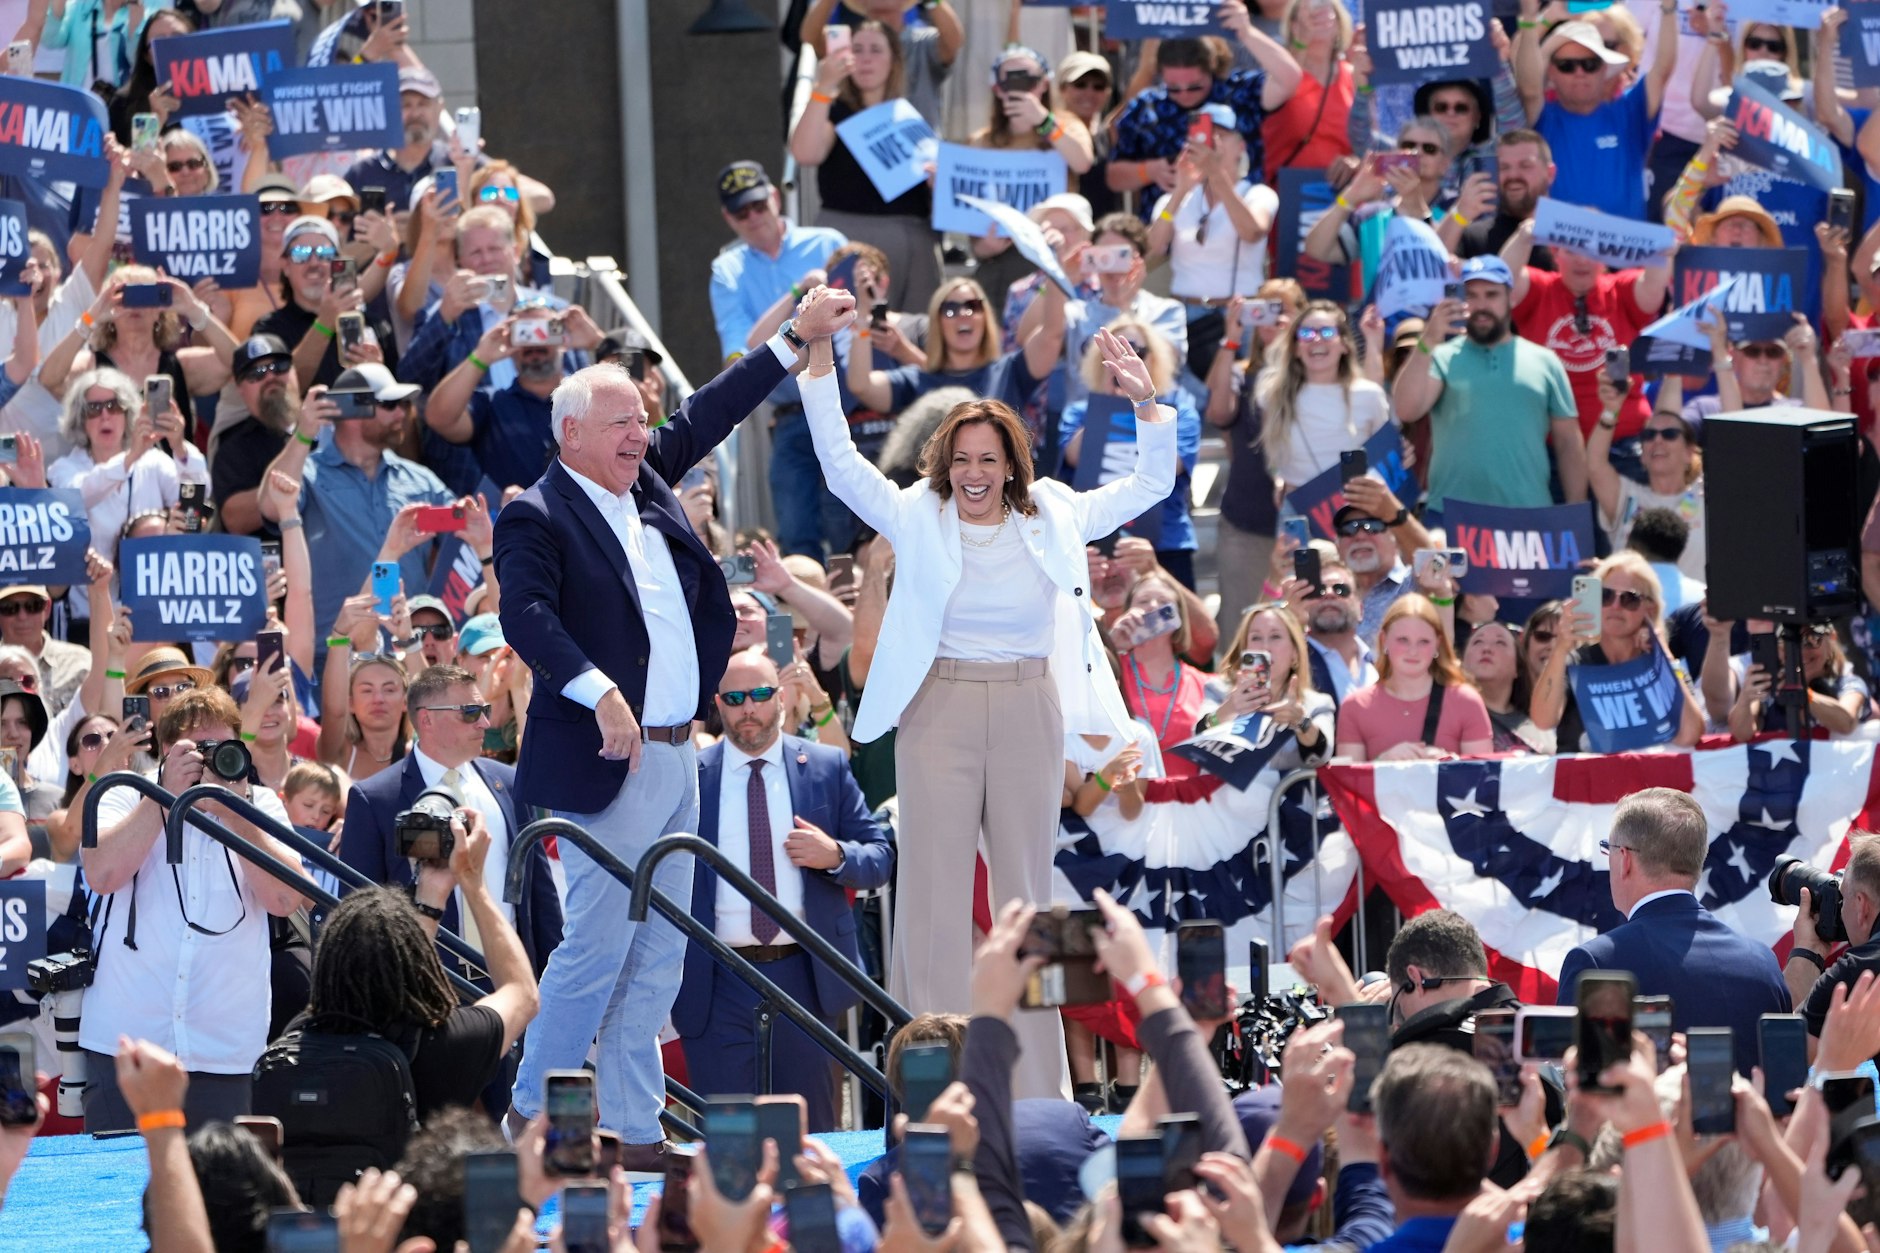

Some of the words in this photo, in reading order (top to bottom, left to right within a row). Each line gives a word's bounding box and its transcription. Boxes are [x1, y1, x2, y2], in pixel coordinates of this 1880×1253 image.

[1134, 4, 1211, 26] WALZ
[1376, 2, 1485, 49] HARRIS
[1395, 43, 1470, 70] WALZ
[273, 84, 316, 100] WHEN
[316, 83, 340, 97] WE
[341, 80, 383, 96] FIGHT
[272, 99, 321, 135] WE
[322, 95, 387, 133] WIN
[1735, 95, 1834, 174] KAMALA
[868, 132, 912, 171] WE
[145, 207, 252, 253] HARRIS
[1553, 220, 1594, 238] WHEN
[1597, 229, 1619, 242] WE
[1621, 233, 1657, 247] VOTE
[166, 251, 238, 277] WALZ
[1456, 523, 1581, 571] KAMALA
[136, 551, 258, 597] HARRIS
[158, 599, 242, 625] WALZ
[1587, 678, 1634, 695] WHEN
[1633, 668, 1656, 688] WE
[1590, 692, 1648, 731] WE
